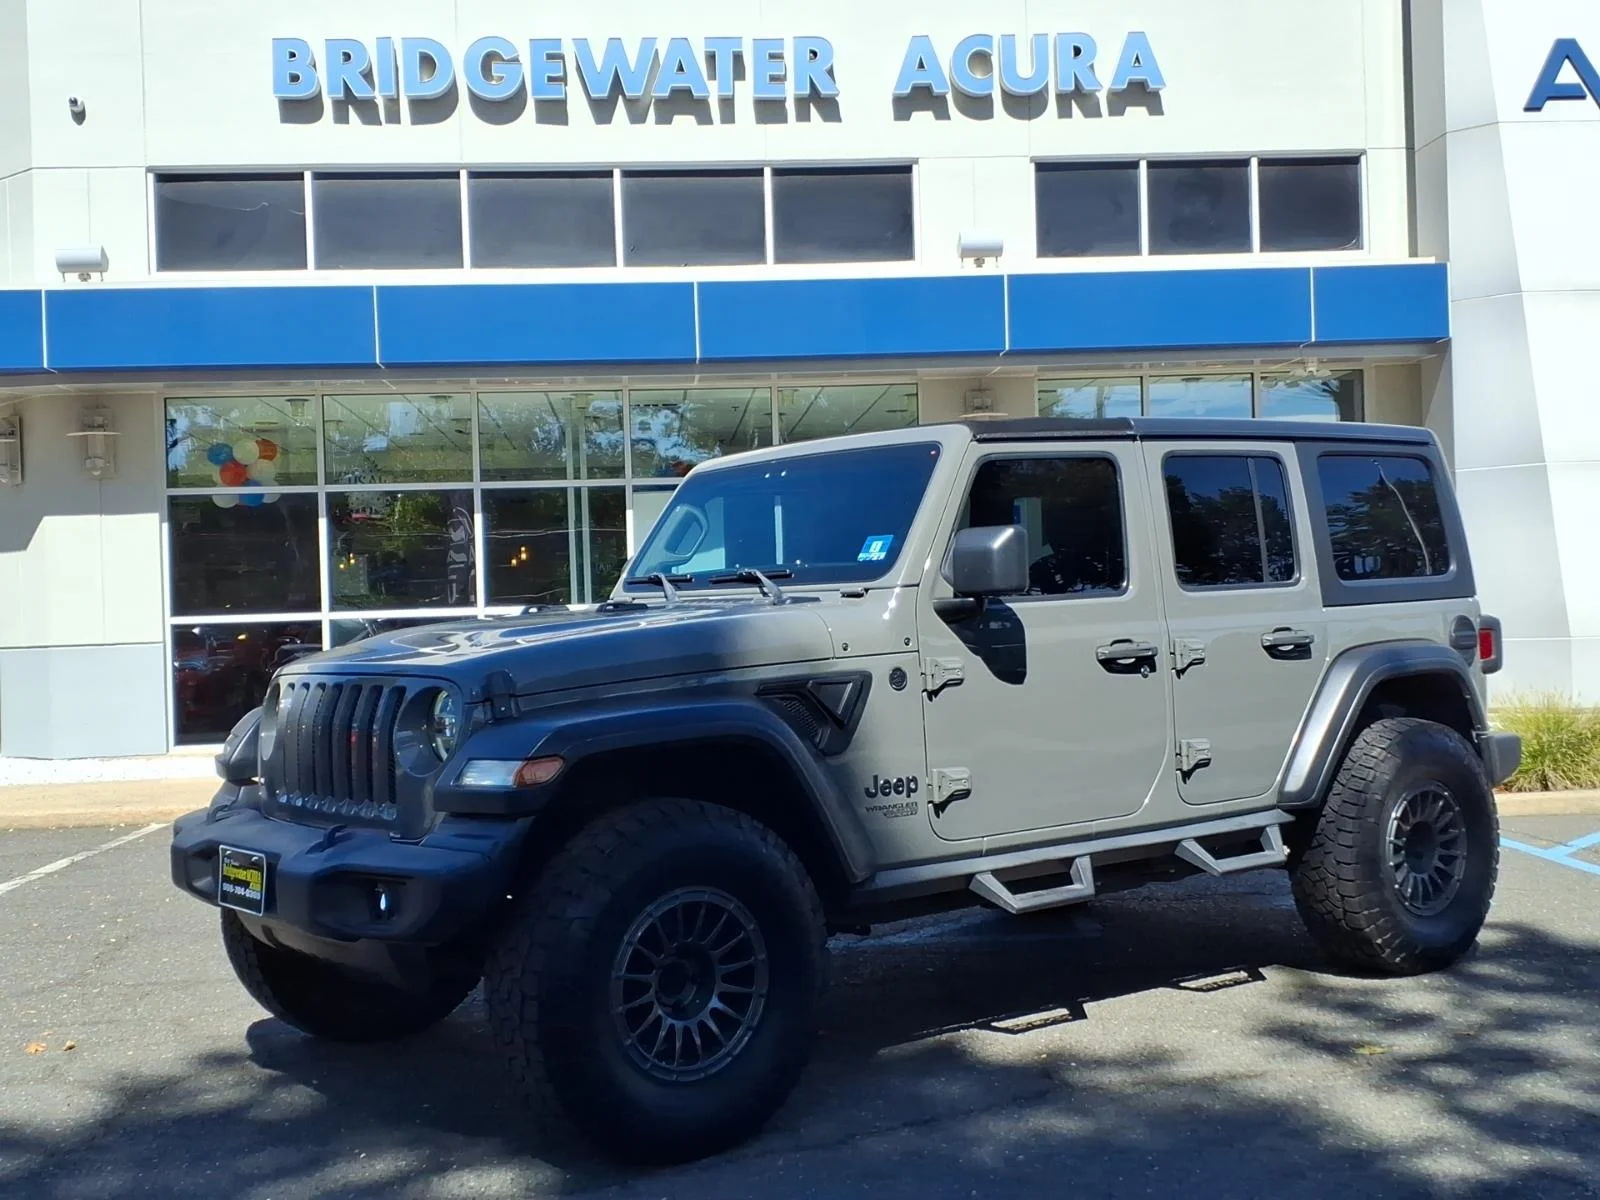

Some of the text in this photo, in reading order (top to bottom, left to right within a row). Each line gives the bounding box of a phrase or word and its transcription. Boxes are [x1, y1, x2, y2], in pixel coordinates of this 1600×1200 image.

[272, 31, 1167, 101] BRIDGEWATER ACURA
[864, 774, 918, 798] Jeep
[864, 801, 918, 812] WRANGLER
